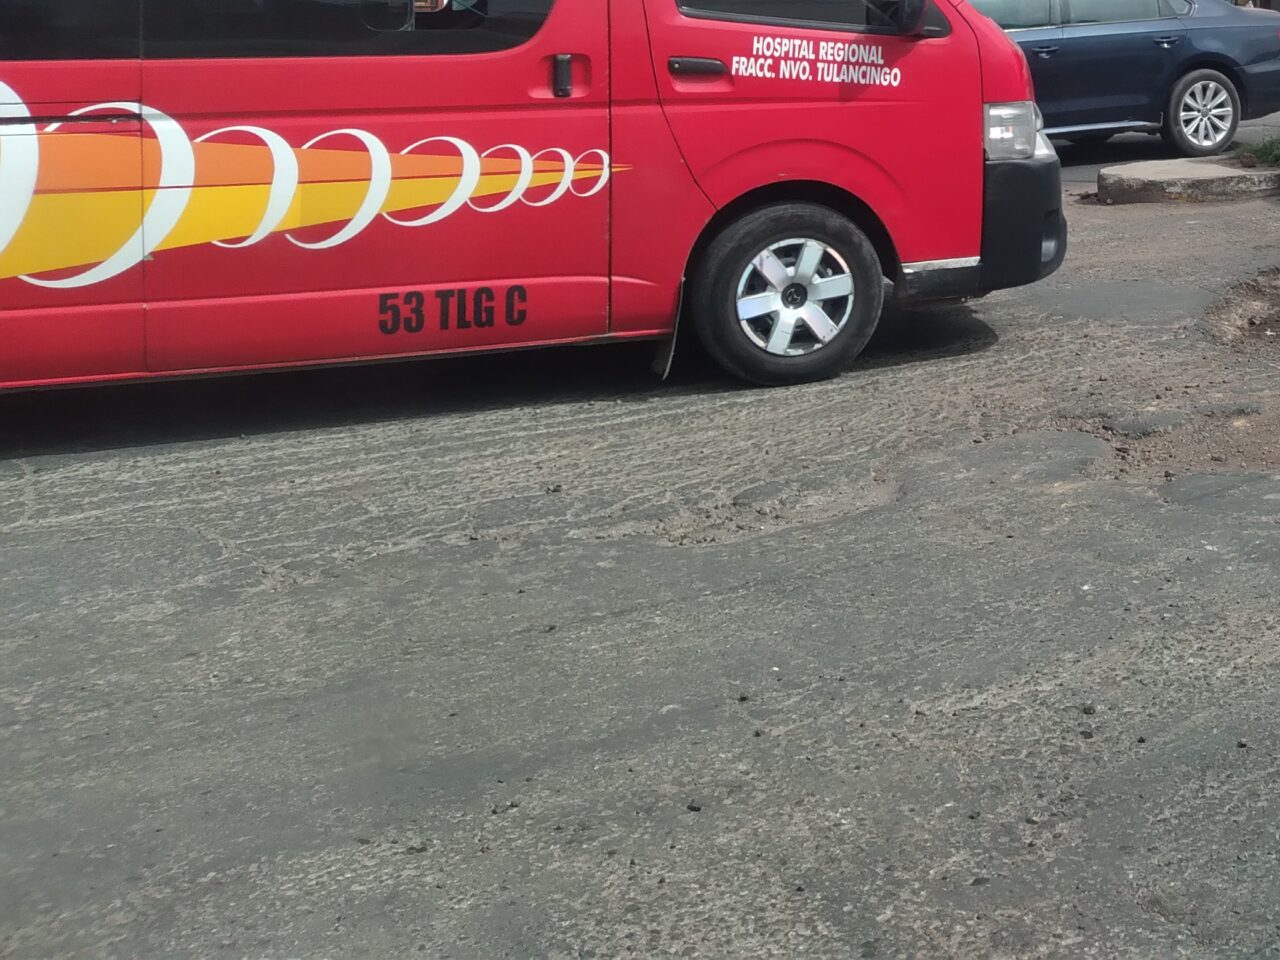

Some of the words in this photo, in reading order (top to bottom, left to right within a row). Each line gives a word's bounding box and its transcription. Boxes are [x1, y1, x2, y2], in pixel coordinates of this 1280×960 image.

[752, 35, 816, 60] HOSPITAL
[818, 41, 884, 65] REGIONAL
[731, 56, 776, 78] FRACC.
[779, 59, 813, 81] NVO.
[816, 62, 901, 87] TULANCINGO
[378, 290, 426, 335] 53
[434, 286, 496, 331] TLG
[504, 284, 528, 327] C
